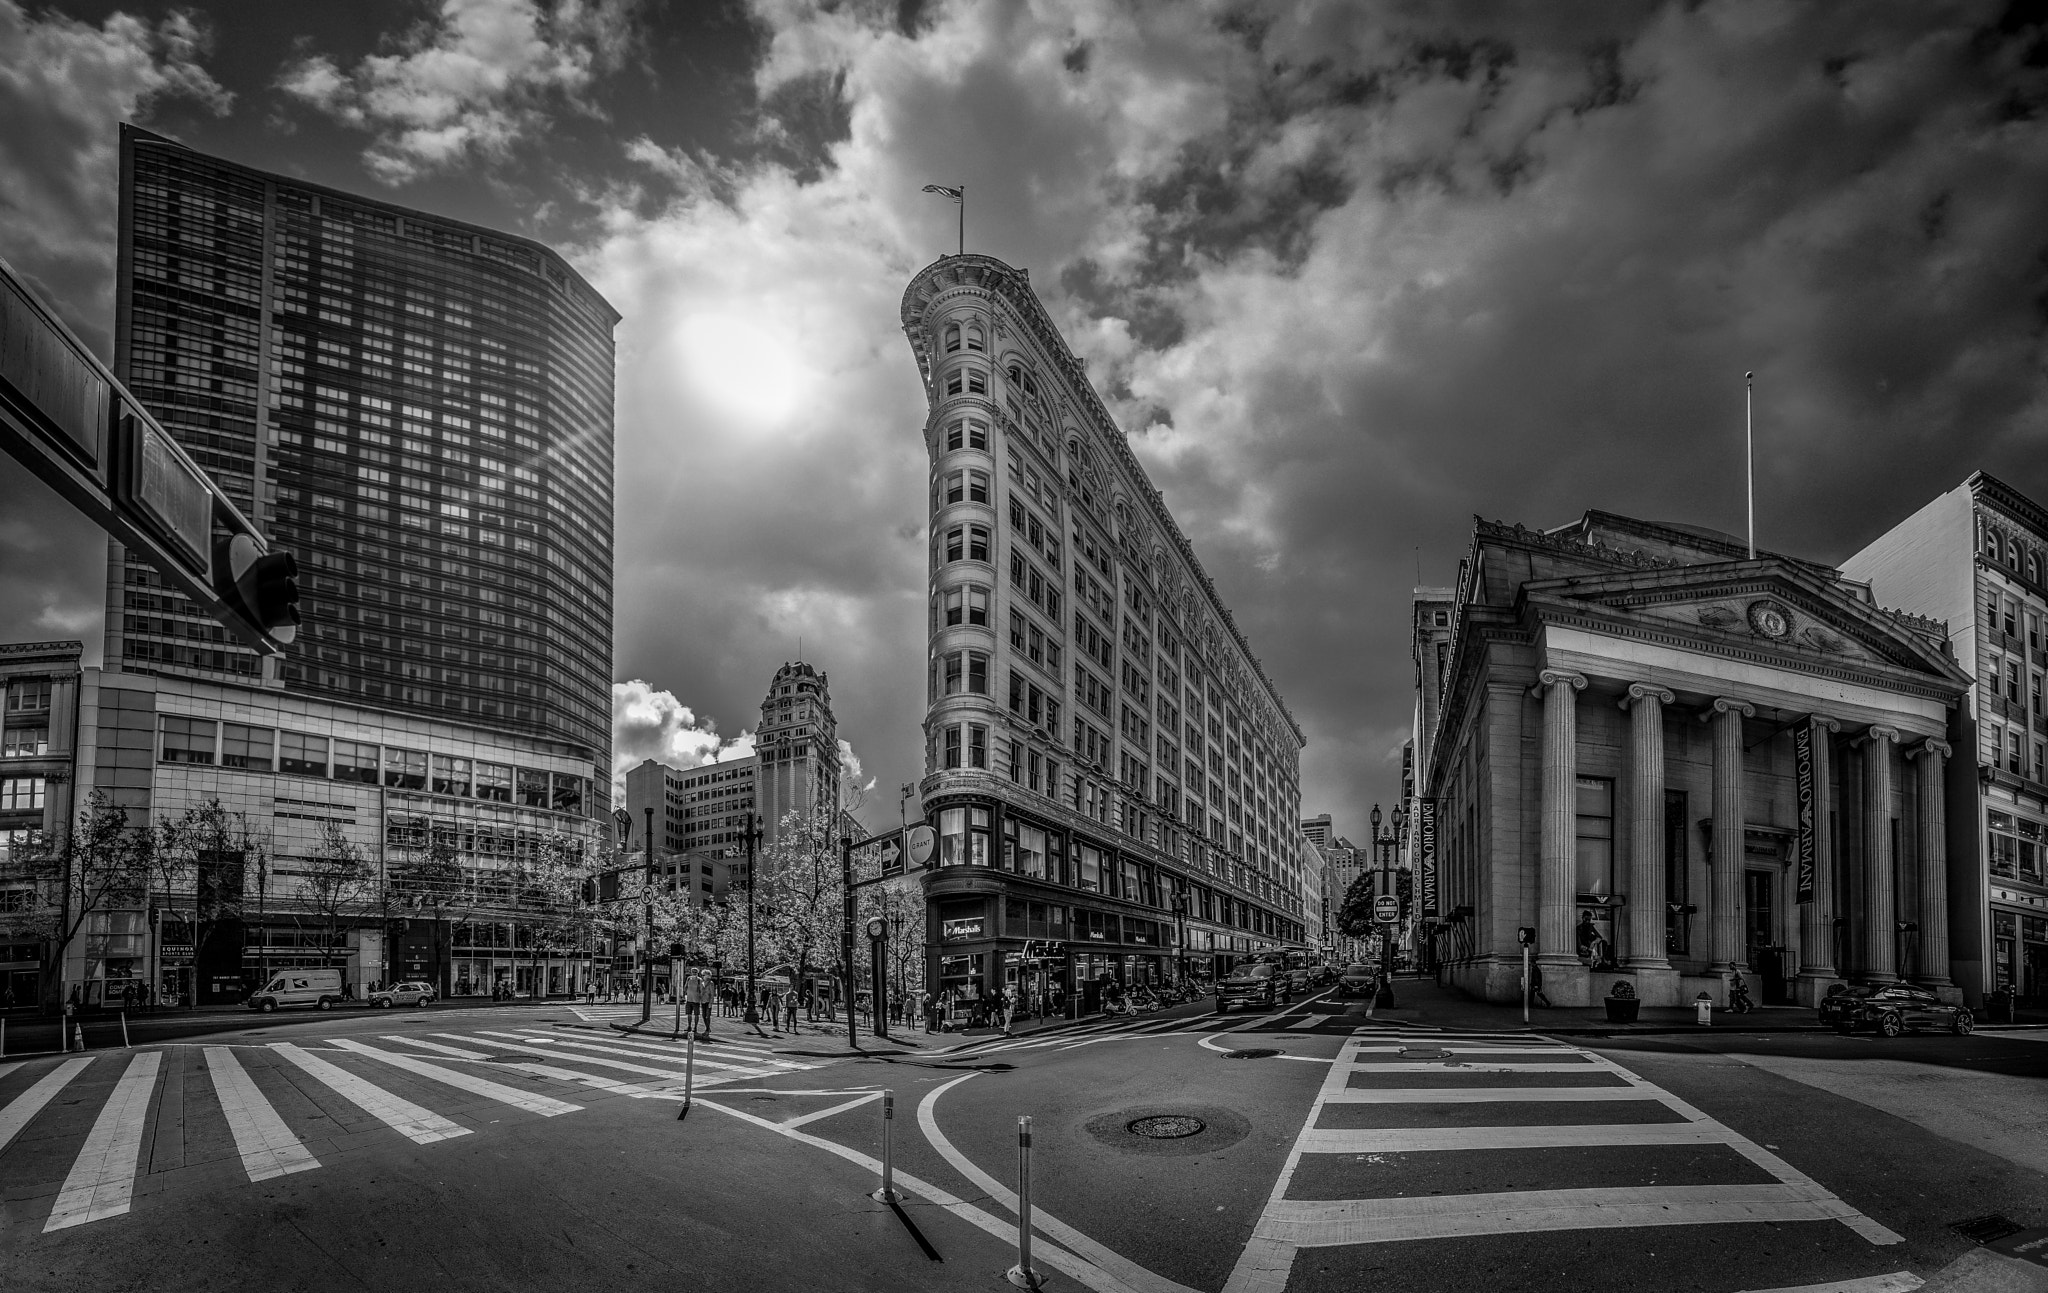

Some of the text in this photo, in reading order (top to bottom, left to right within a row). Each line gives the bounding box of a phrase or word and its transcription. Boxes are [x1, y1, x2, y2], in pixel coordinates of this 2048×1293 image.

[1796, 727, 1812, 892] EMPORIO ARMANI
[911, 839, 931, 850] GRANT
[1423, 803, 1436, 910] EMPORIO ARMANI
[952, 924, 981, 935] Marshalls
